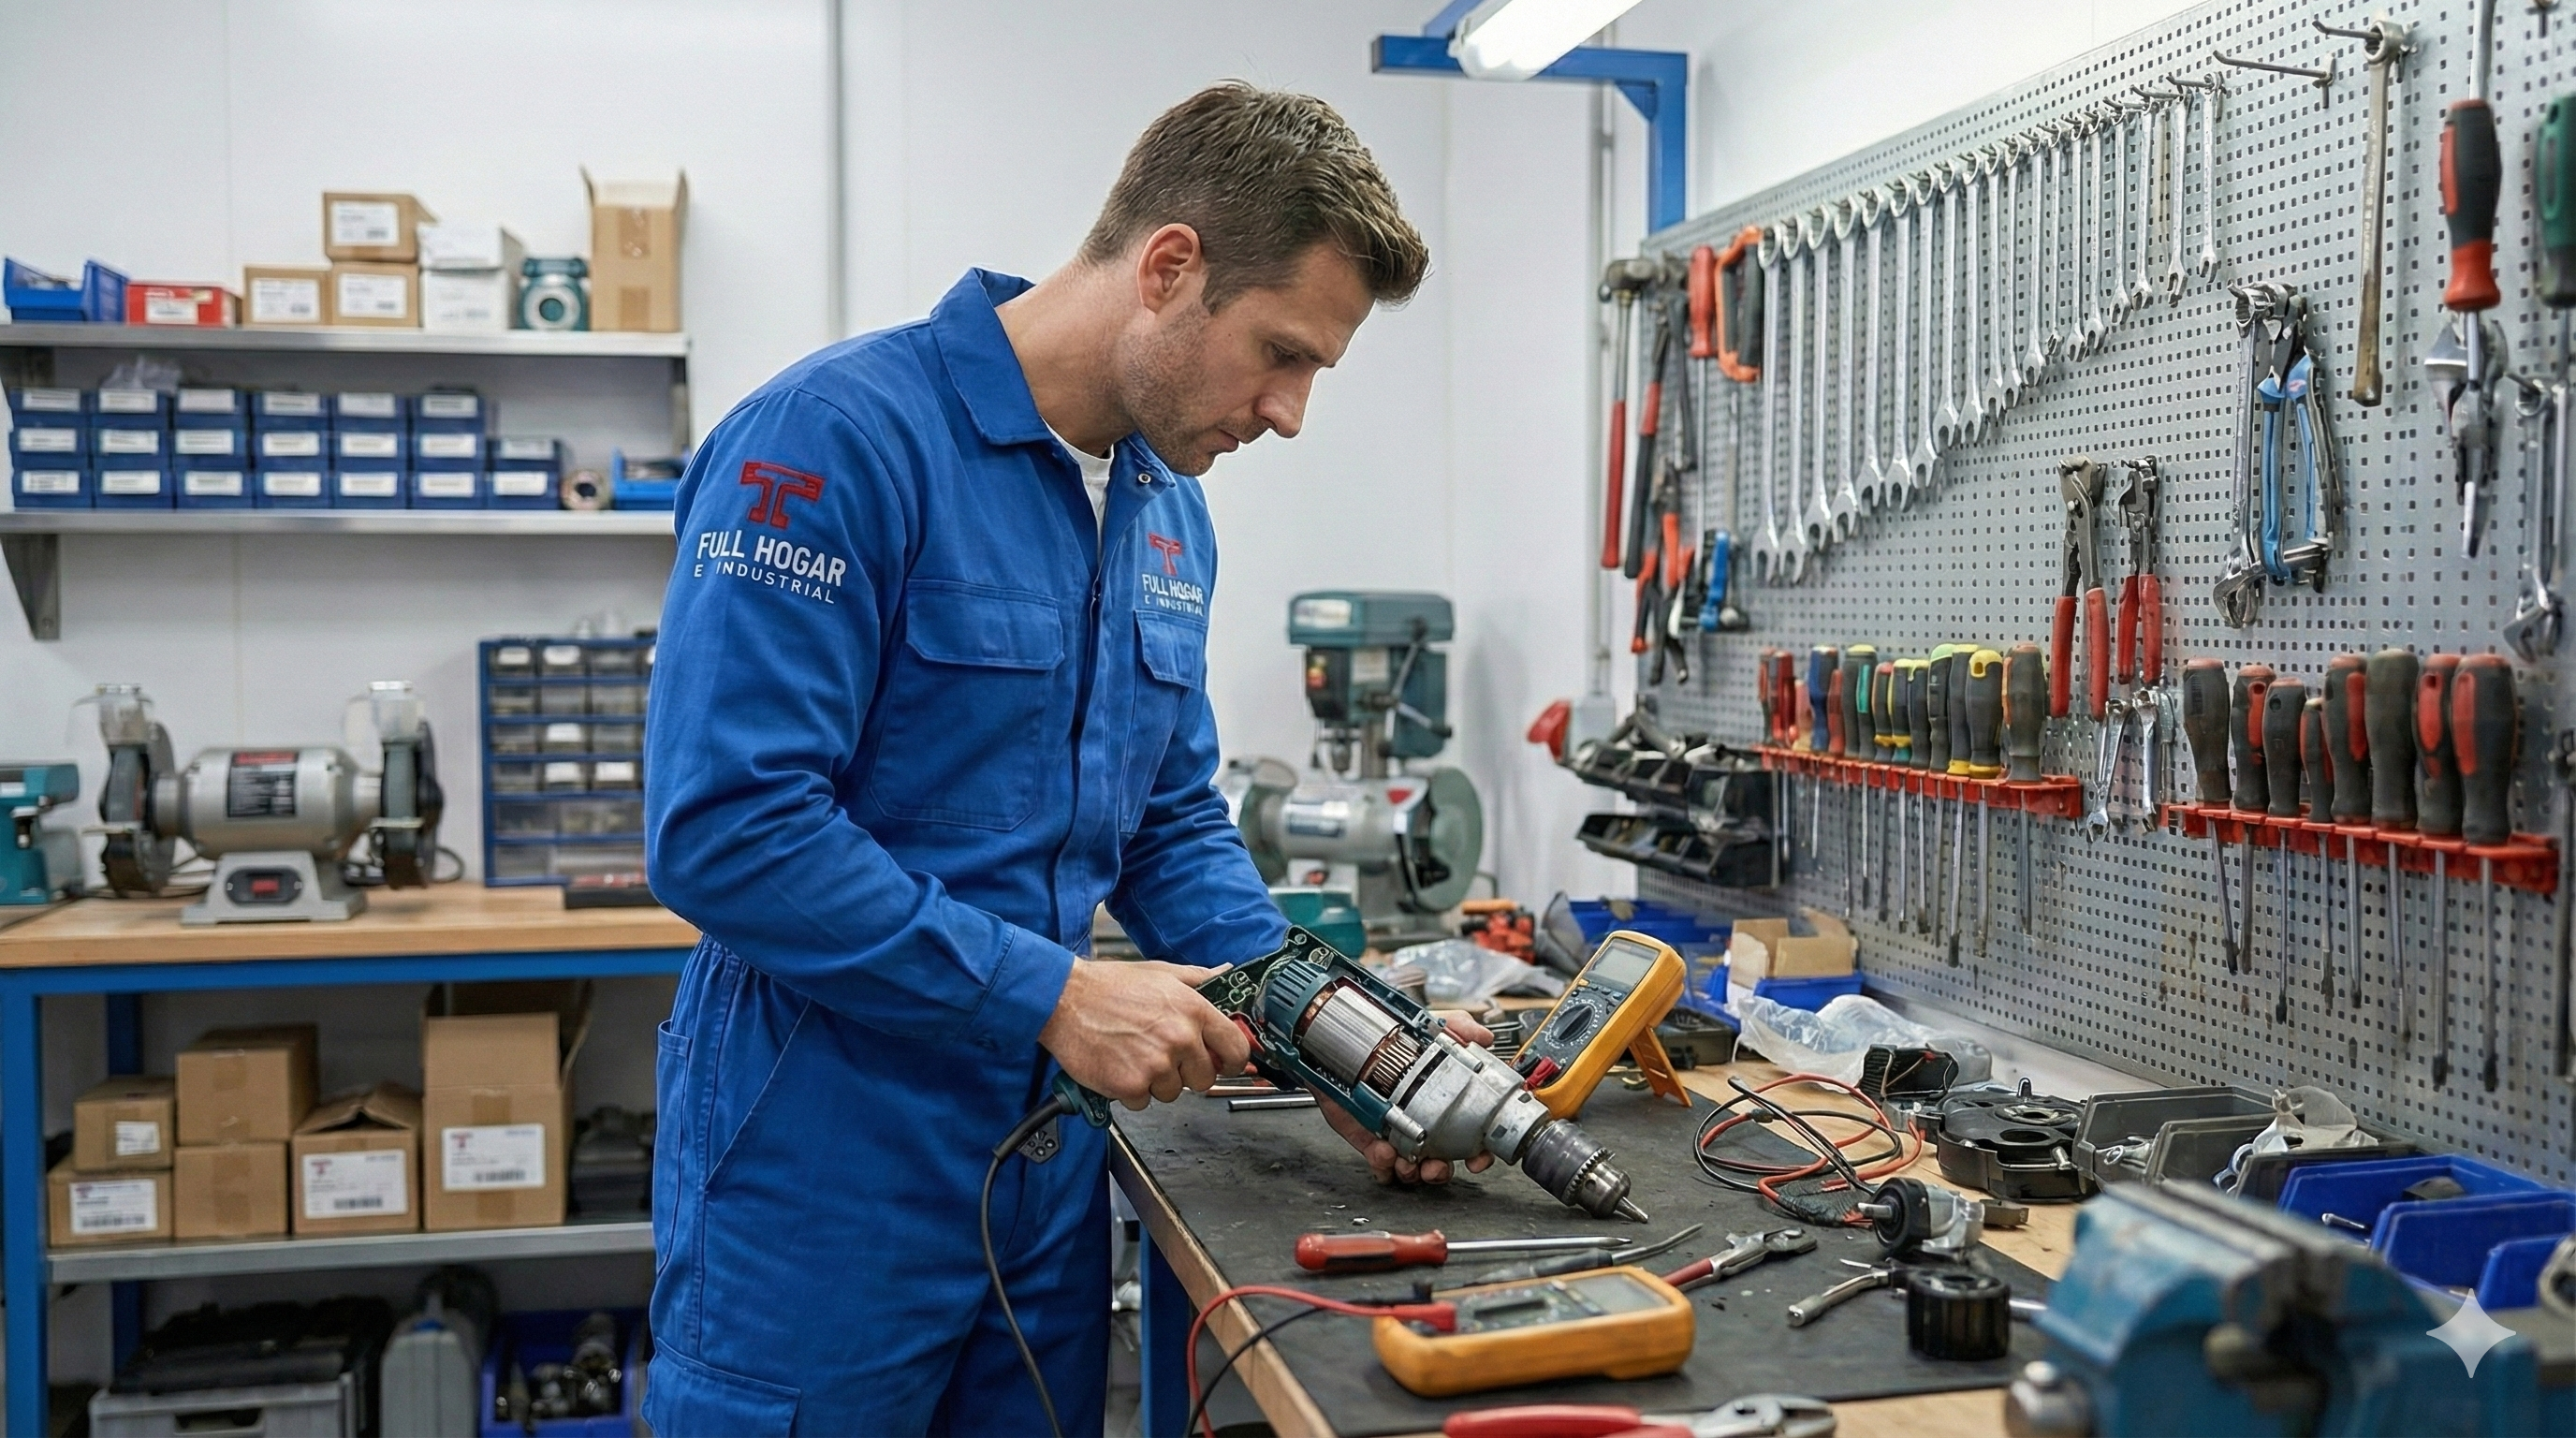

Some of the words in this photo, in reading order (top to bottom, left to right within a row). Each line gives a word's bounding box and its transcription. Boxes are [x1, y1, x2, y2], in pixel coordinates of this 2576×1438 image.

[696, 529, 745, 560] FULL
[754, 535, 846, 587] HOGAR
[694, 564, 704, 578] E
[715, 562, 835, 605] INDUSTRIAL
[1142, 573, 1169, 596] FULL
